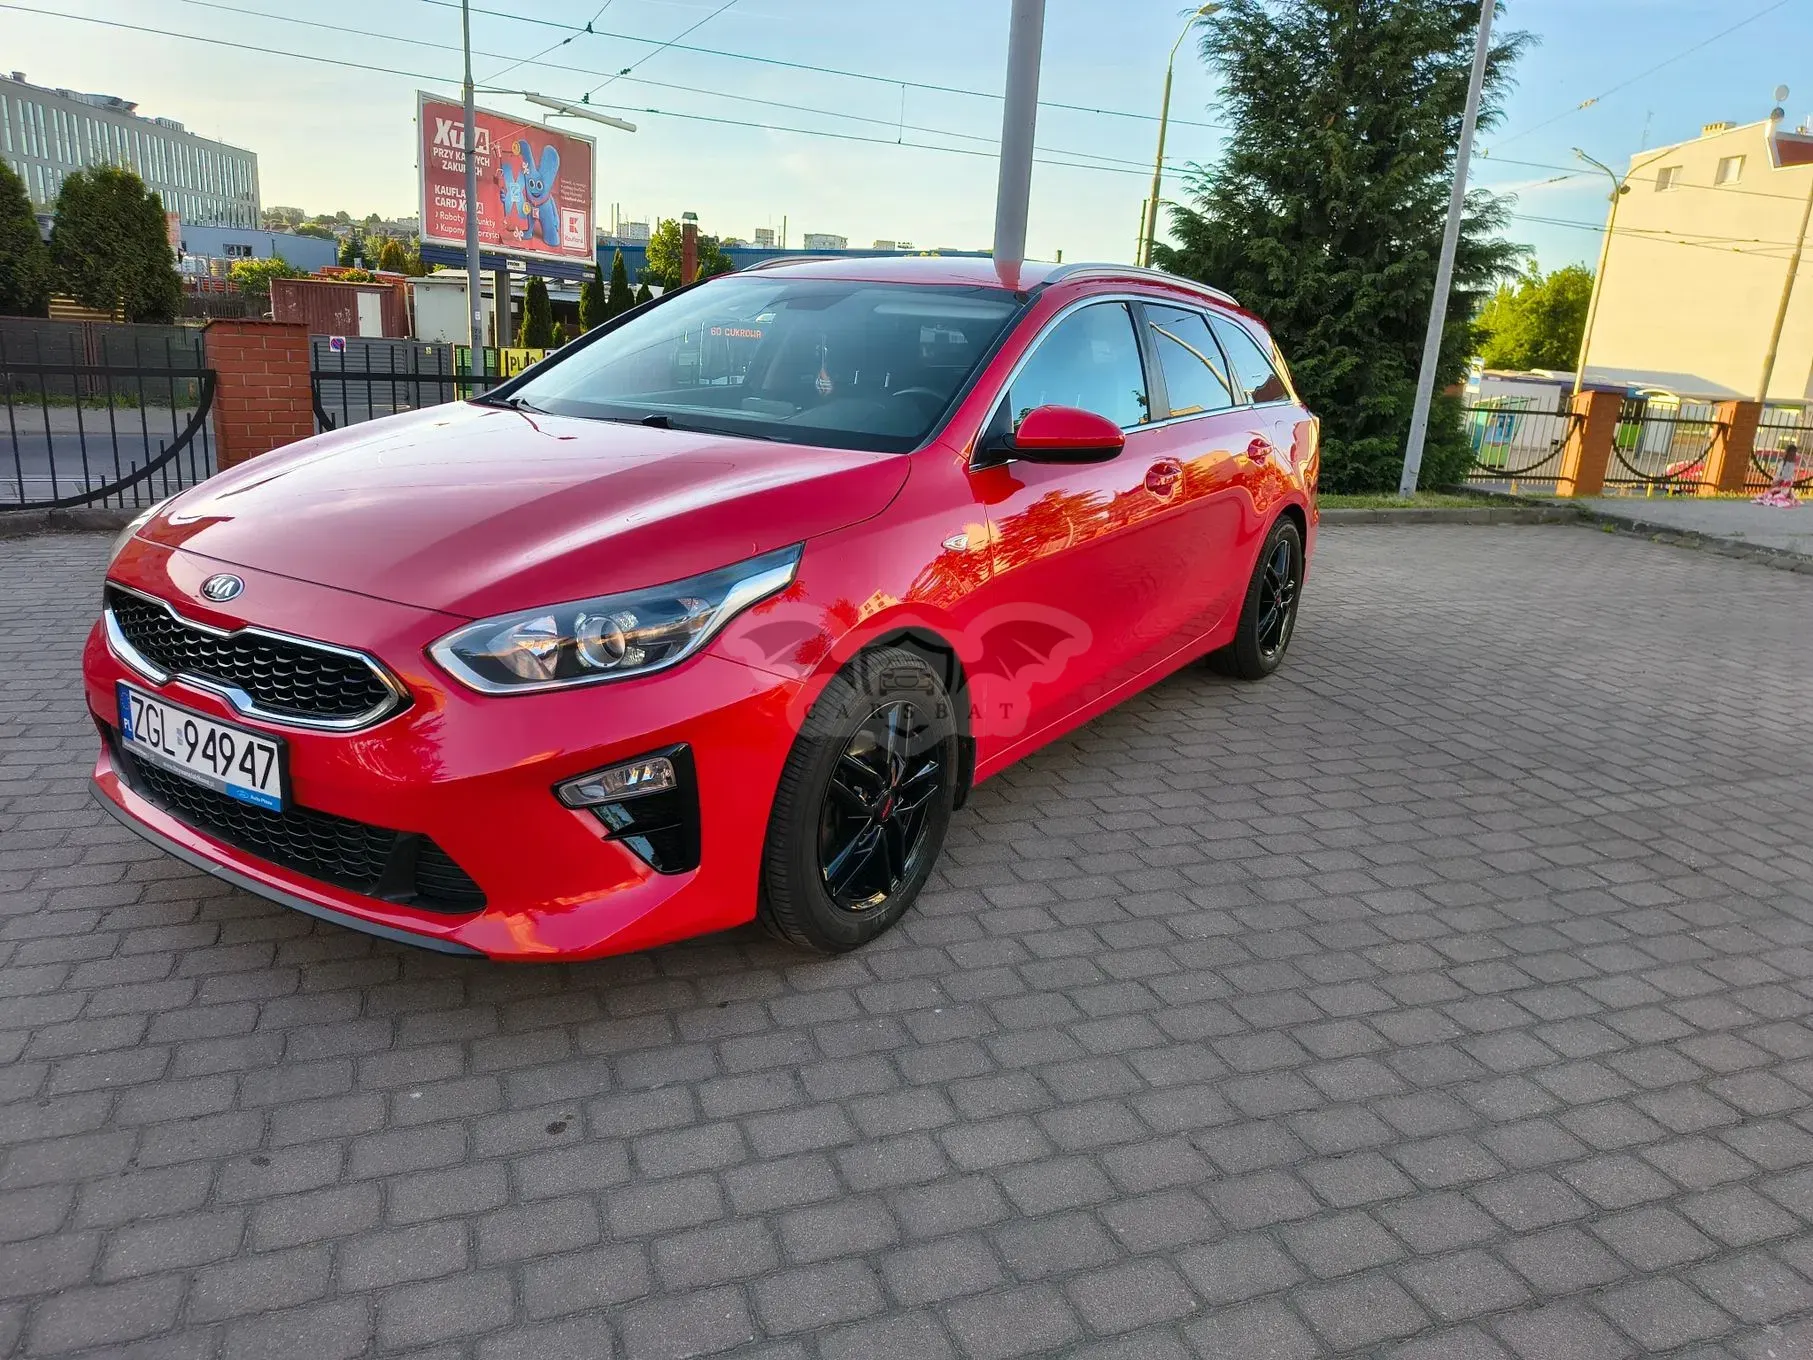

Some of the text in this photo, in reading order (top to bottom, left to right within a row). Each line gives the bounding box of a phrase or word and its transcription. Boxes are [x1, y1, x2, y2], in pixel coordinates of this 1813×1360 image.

[433, 146, 455, 160] PRZY
[434, 184, 467, 199] KAUFLA
[435, 196, 457, 209] CARD
[440, 223, 466, 236] Kupony
[123, 717, 133, 732] PL
[131, 695, 176, 757] ZGL
[183, 719, 276, 791] 94947
